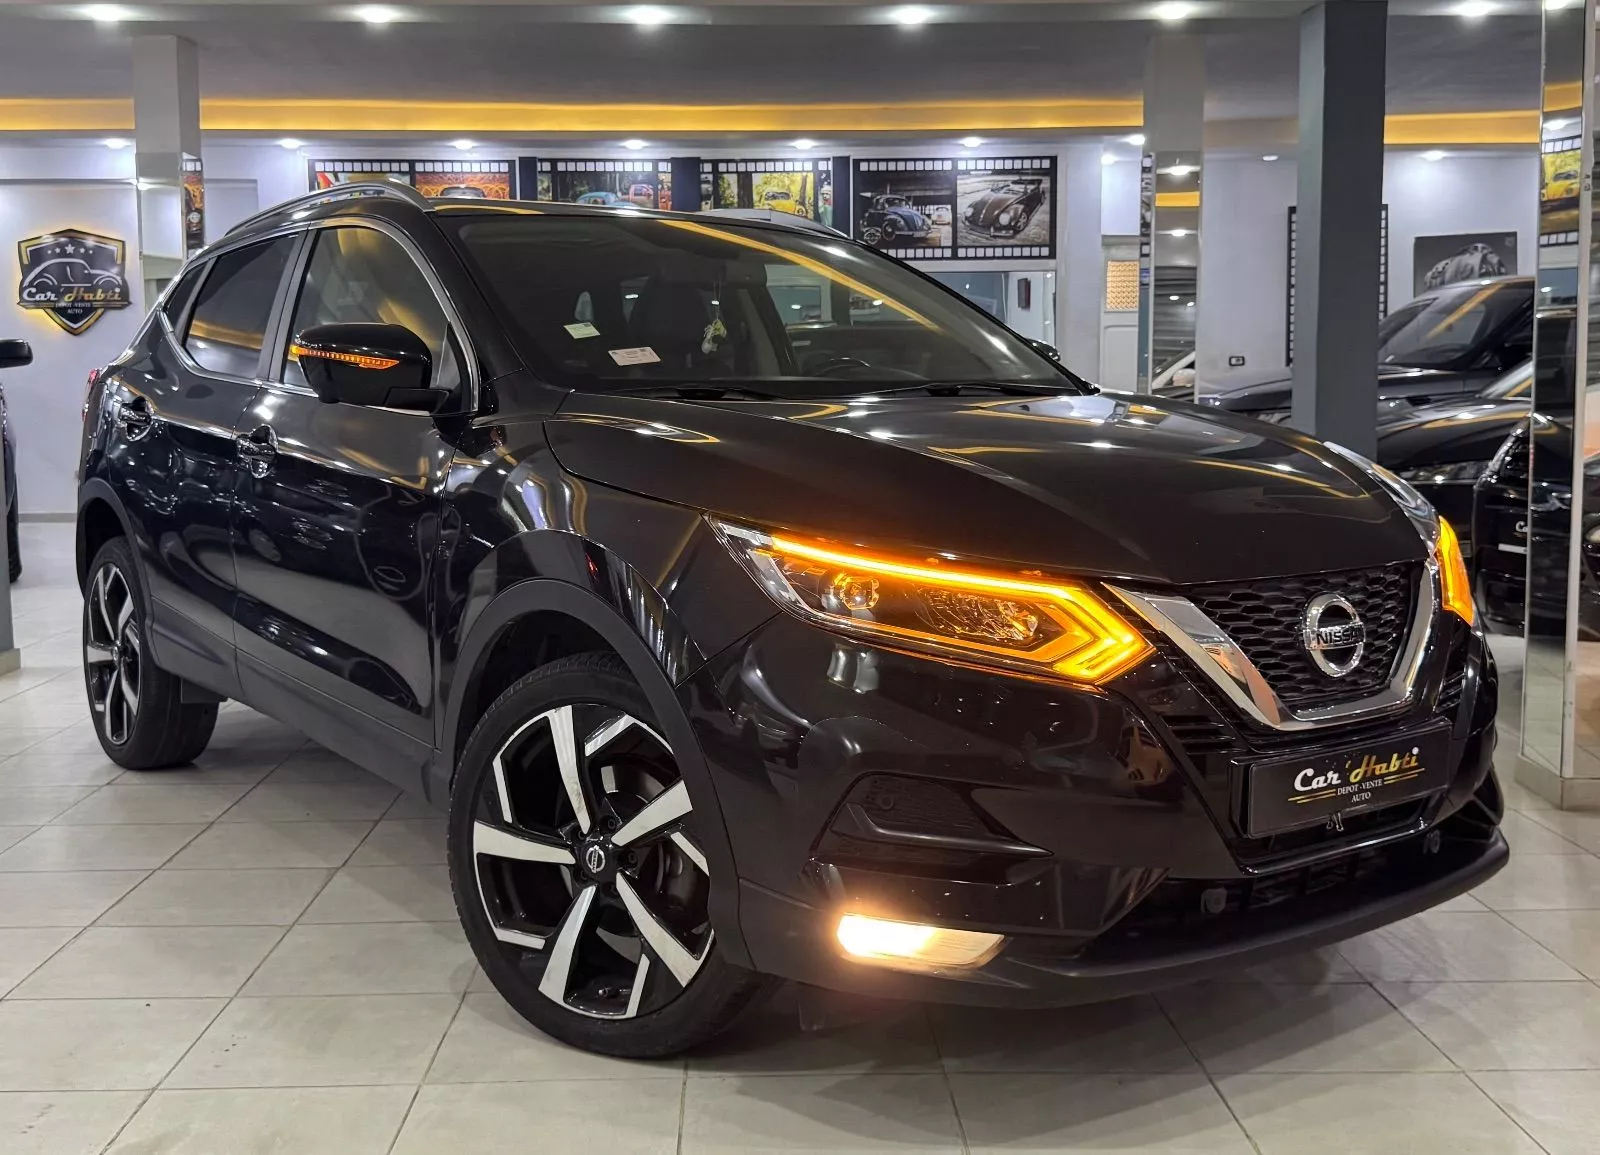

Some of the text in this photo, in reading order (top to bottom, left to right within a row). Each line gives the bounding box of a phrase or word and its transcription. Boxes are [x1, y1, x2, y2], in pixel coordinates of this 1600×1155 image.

[22, 287, 58, 301] Car
[1515, 521, 1528, 532] Ca
[1294, 768, 1342, 791] Car
[1351, 791, 1372, 803] AUTO
